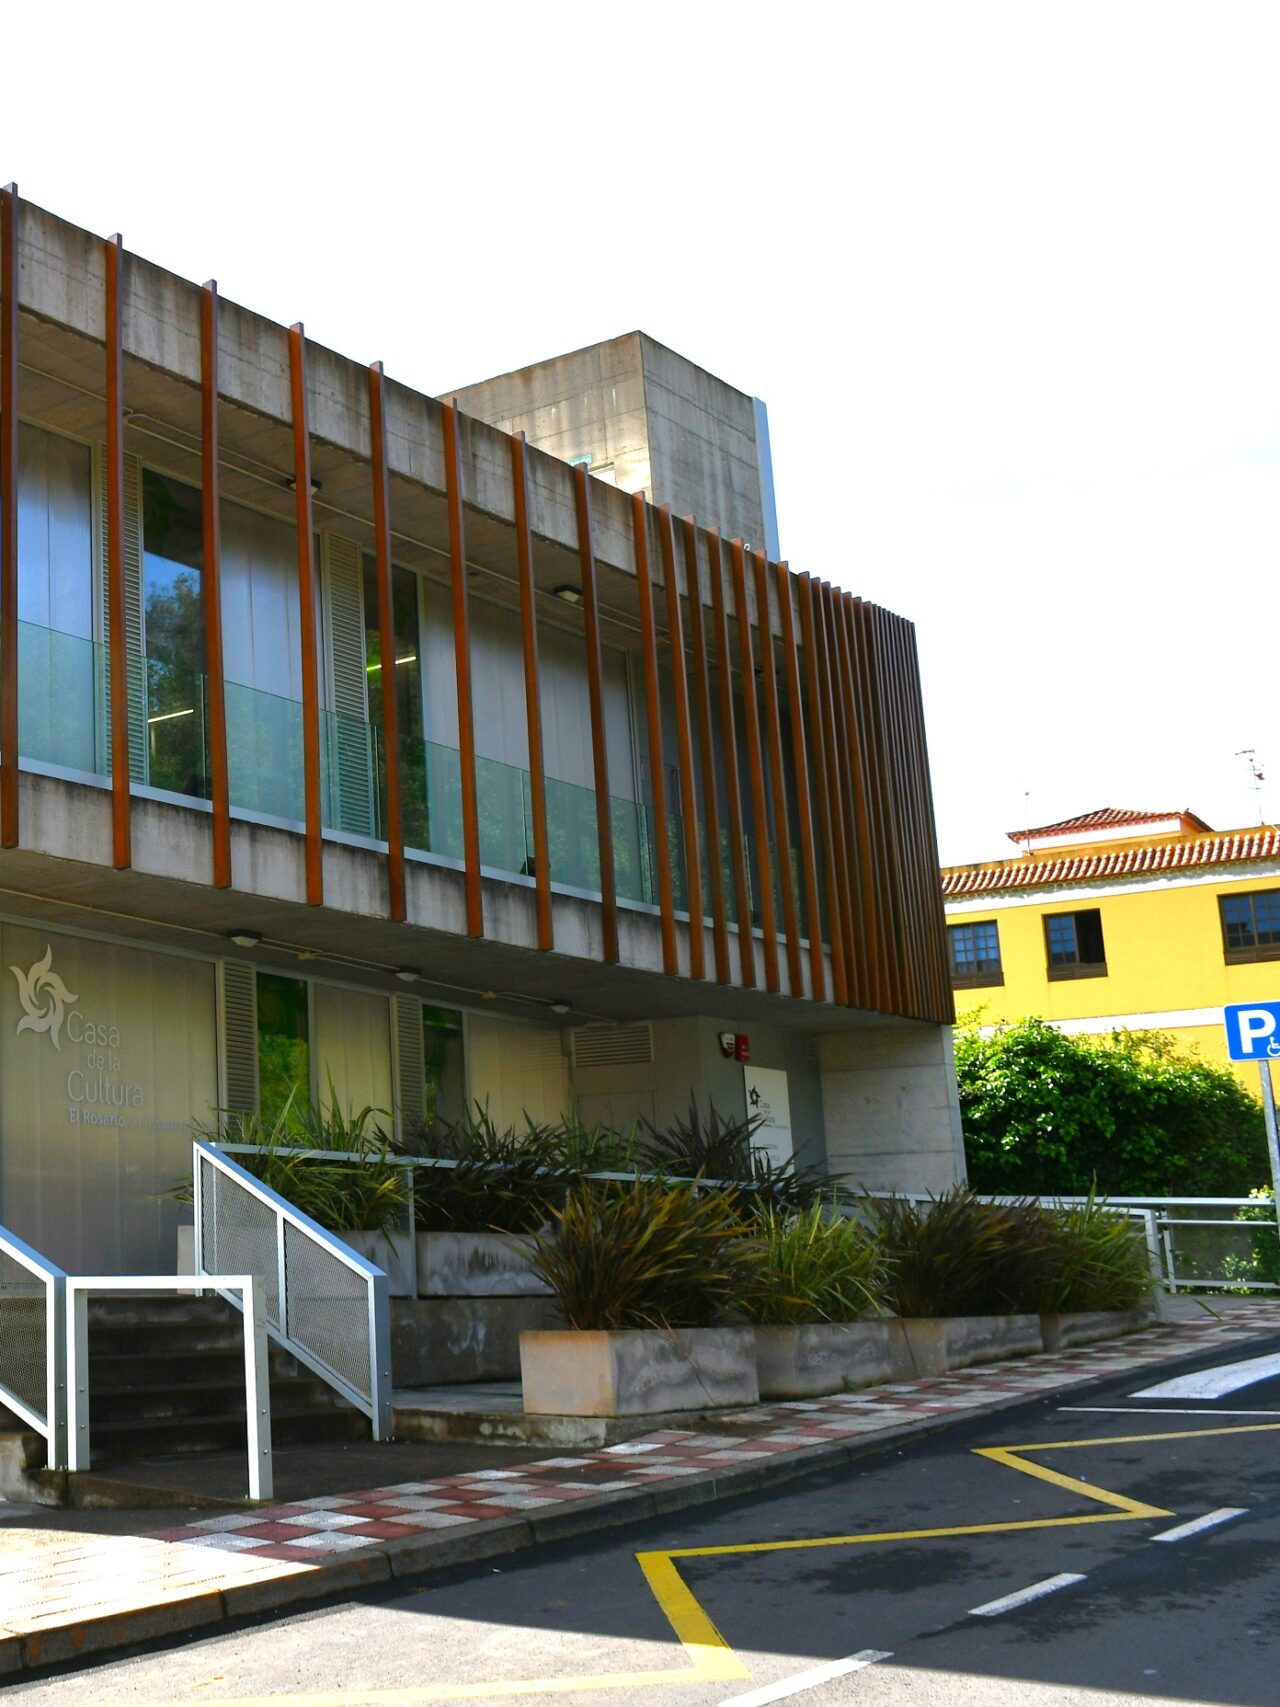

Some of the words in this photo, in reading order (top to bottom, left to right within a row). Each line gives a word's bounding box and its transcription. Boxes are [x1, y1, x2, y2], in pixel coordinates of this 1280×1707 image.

[67, 1011, 120, 1048] Casa
[1237, 1009, 1277, 1054] P
[87, 1047, 105, 1070] de
[108, 1049, 120, 1072] la
[67, 1070, 145, 1108] Cultura
[70, 1107, 80, 1123] El
